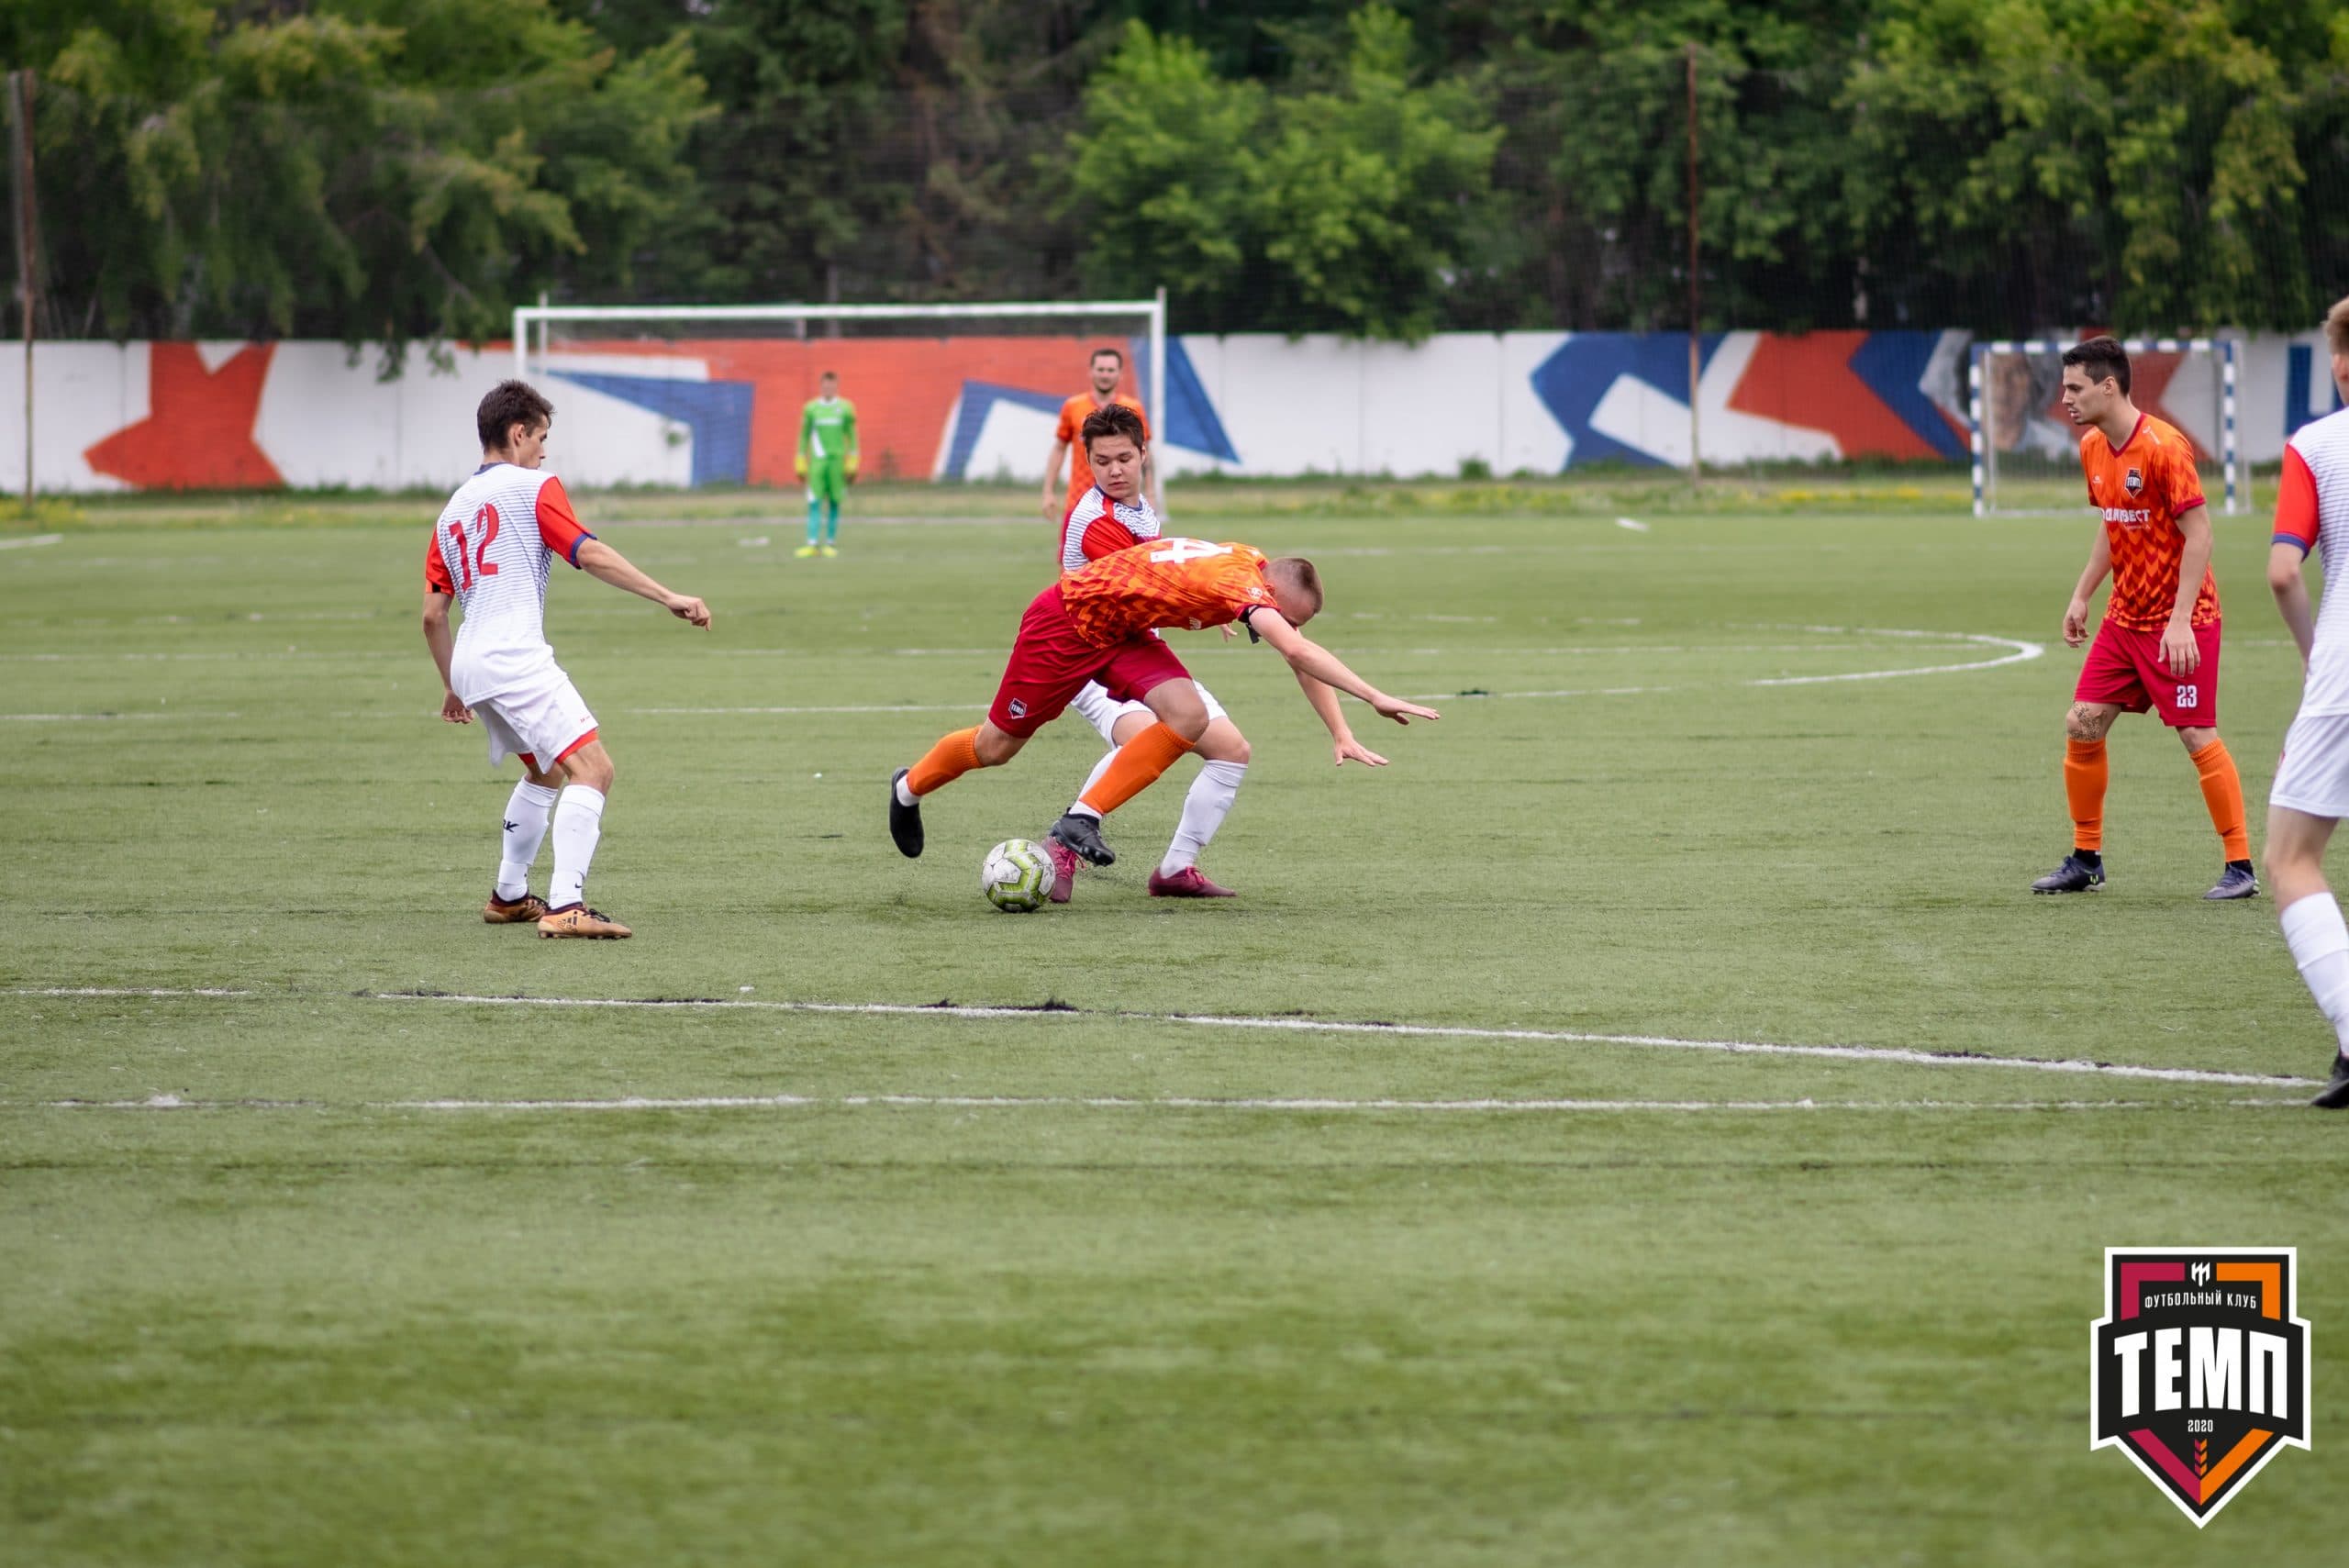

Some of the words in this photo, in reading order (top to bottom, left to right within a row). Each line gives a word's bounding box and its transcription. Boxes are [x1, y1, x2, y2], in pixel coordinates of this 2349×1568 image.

[448, 502, 500, 593] 12
[1150, 537, 1233, 564] 4
[2176, 684, 2198, 708] 23
